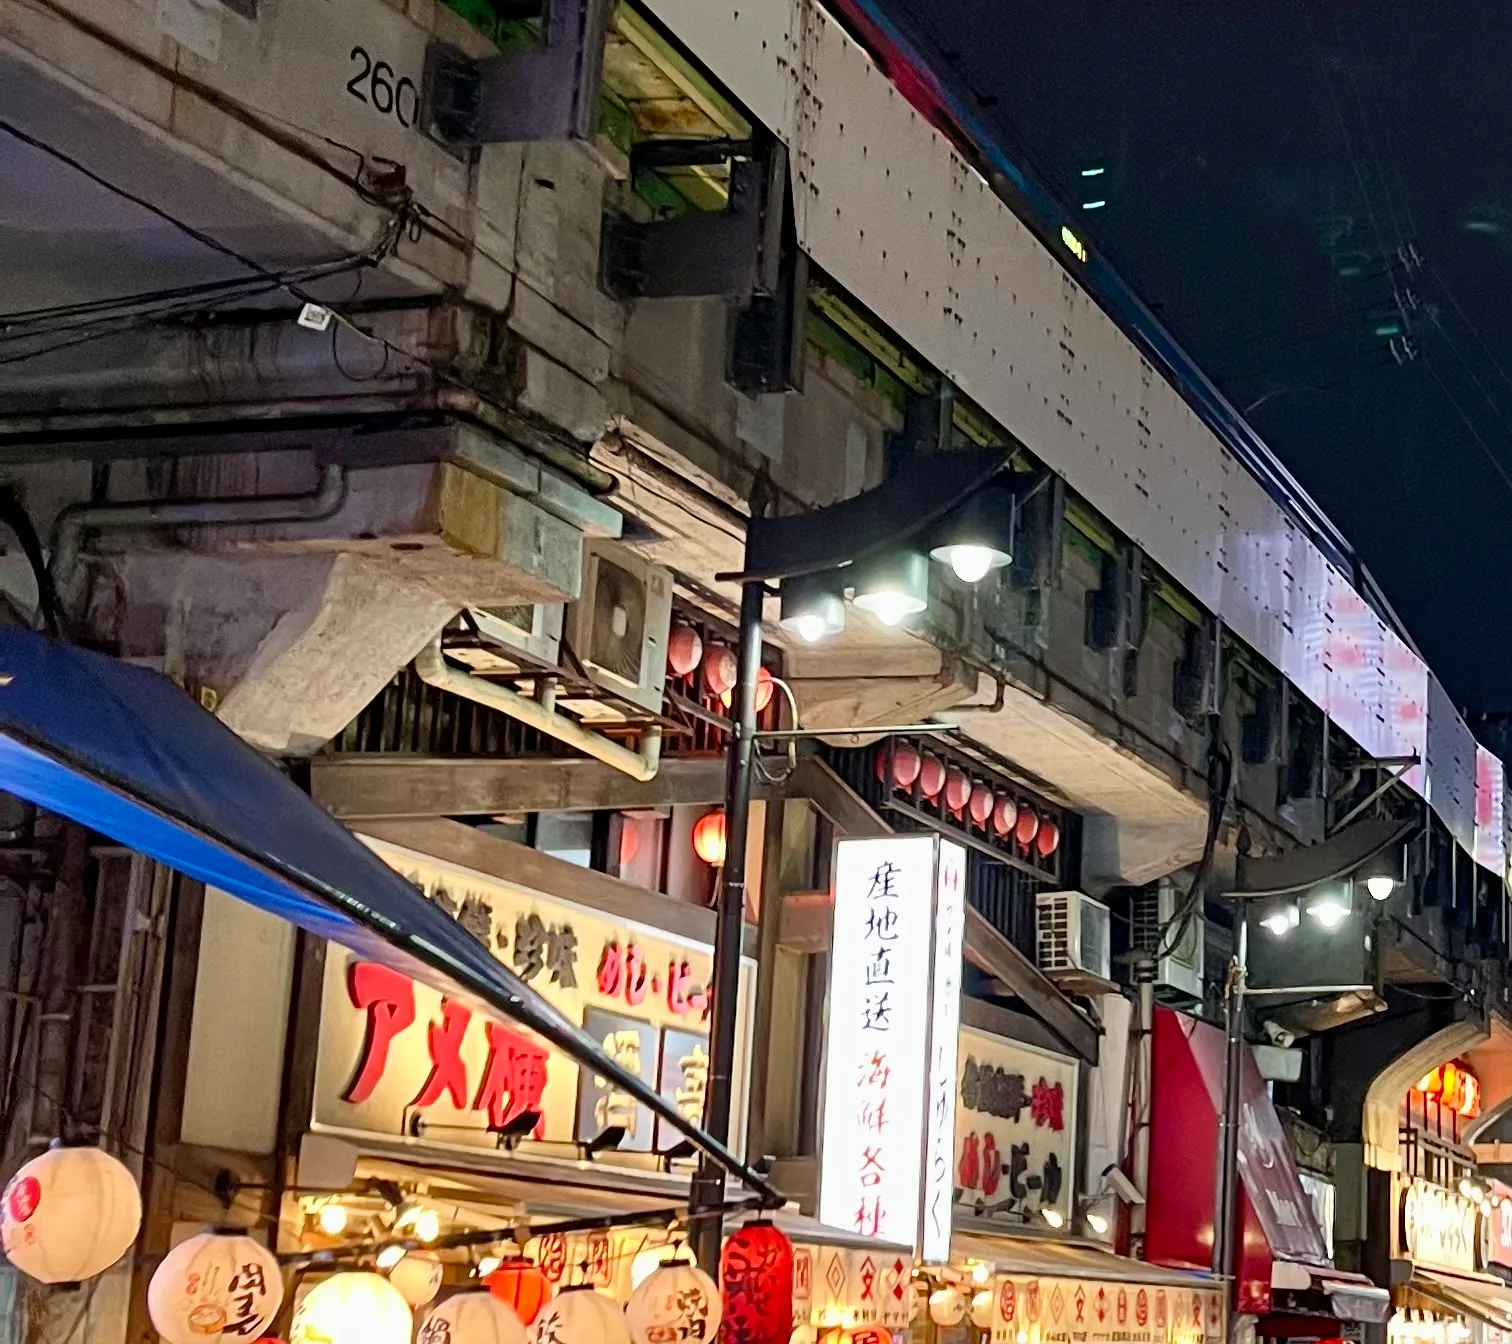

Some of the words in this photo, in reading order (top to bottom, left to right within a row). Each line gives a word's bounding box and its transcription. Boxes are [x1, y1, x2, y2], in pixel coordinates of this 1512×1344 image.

[347, 45, 419, 128] 260
[861, 861, 902, 1032] 産地直送
